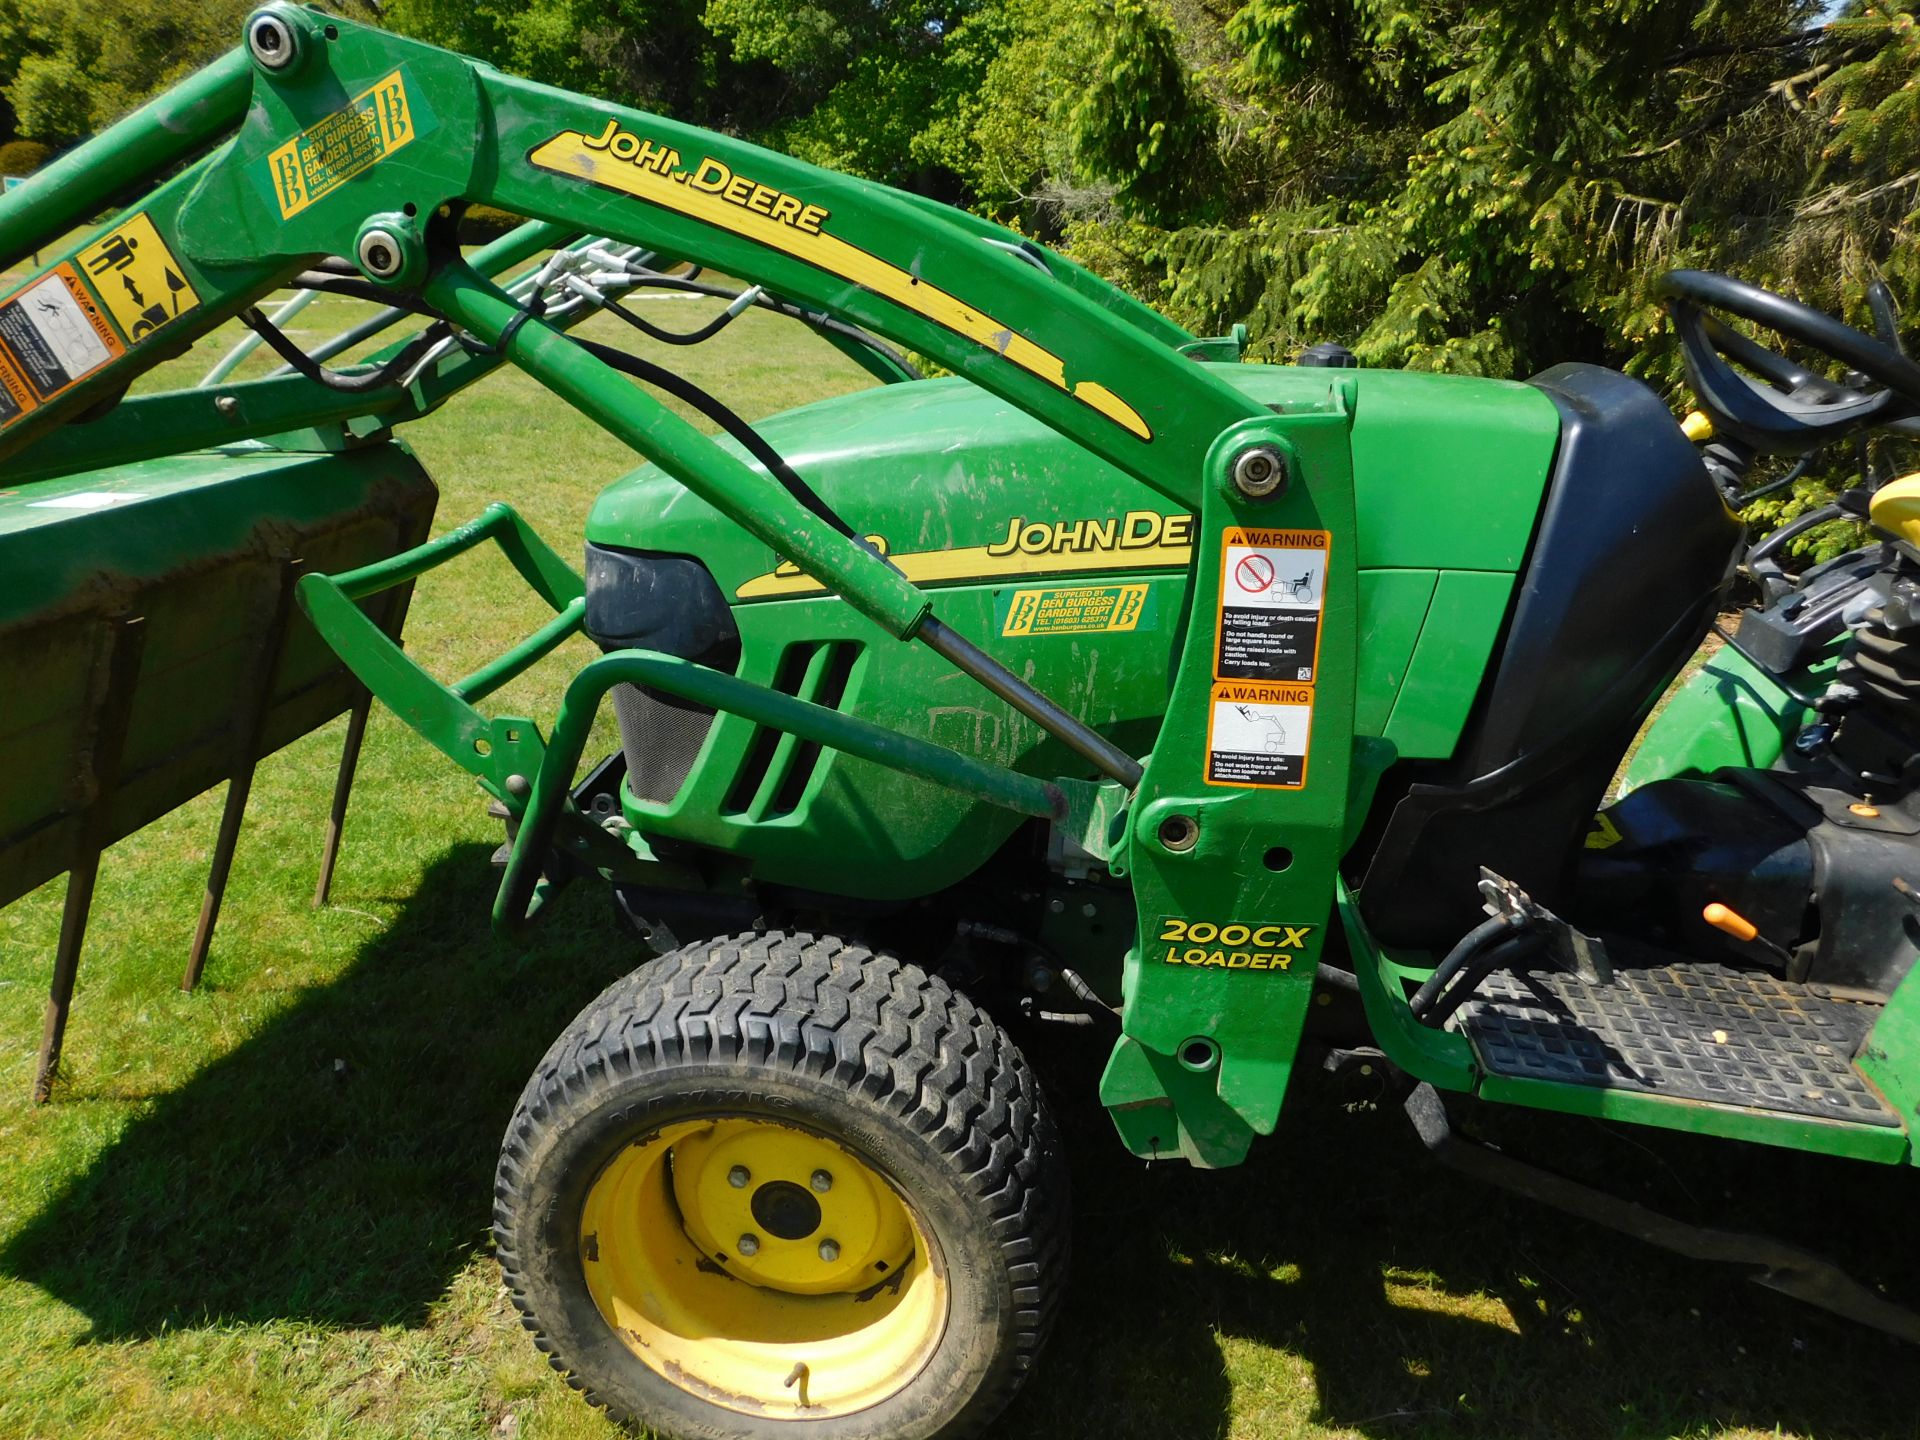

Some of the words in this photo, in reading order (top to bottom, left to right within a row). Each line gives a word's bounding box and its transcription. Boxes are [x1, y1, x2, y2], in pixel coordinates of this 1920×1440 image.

[301, 139, 324, 163] BEN
[325, 106, 375, 148] BURGESS
[309, 113, 347, 142] SUPPLIED
[582, 118, 689, 182] JOHN
[691, 156, 831, 235] DEERE
[75, 288, 116, 346] WANING
[988, 517, 1119, 556] JOHN
[1119, 511, 1194, 549] DE
[1245, 532, 1325, 547] WARNING
[1054, 590, 1092, 599] SUPPLIED
[1041, 599, 1064, 609] BEN
[1066, 596, 1116, 608] BURGESS
[1038, 606, 1081, 618] GARDEN
[1084, 605, 1112, 616] EQPT
[1081, 615, 1108, 623] 625370
[1034, 622, 1105, 632] www.benburgess.co.uk
[1233, 688, 1309, 703] WARNING
[1238, 754, 1255, 762] injury
[1159, 919, 1312, 949] 200CX
[1165, 946, 1293, 971] LOADER
